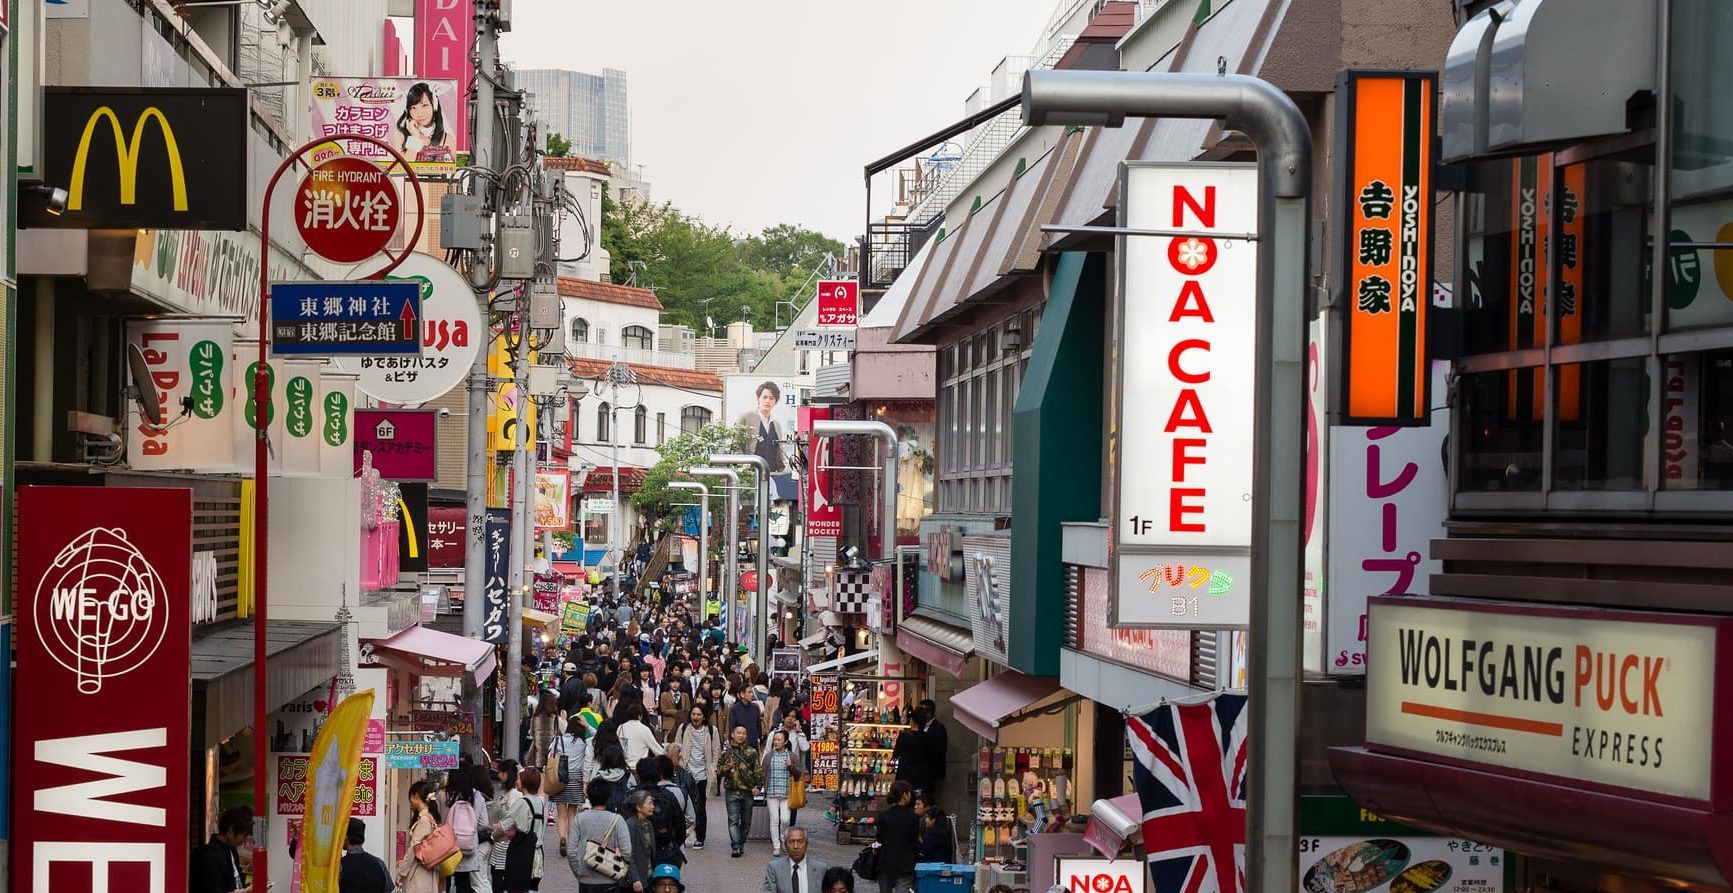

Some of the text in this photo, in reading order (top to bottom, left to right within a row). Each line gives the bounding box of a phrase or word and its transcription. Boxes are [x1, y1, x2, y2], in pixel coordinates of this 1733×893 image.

[334, 106, 389, 121] カラコン
[322, 123, 389, 139] つけまつげ
[312, 170, 383, 184] FIRE HYDRANT
[303, 188, 392, 232] 消火栓
[1167, 184, 1218, 324] NOA
[1357, 178, 1396, 316] 吉野家
[1400, 185, 1419, 312] YOSHINOYA
[298, 296, 392, 317] 東郷神社
[826, 313, 857, 323] アガサ
[299, 321, 398, 342] 東郷記念館
[817, 334, 854, 348] クリスティー
[199, 342, 215, 417] ラパウザ
[293, 378, 306, 436] ラパウザ
[330, 393, 342, 446] ラパウザ
[378, 426, 393, 437] 6F
[1163, 338, 1214, 533] CAFE
[1361, 425, 1422, 599] レープ
[428, 521, 466, 535] セサリー
[808, 520, 841, 528] WONDER
[809, 528, 841, 536] ROCKET
[1129, 515, 1153, 535] 1F
[484, 576, 507, 641] ハセガワ
[1171, 595, 1199, 617] B1
[1398, 627, 1566, 705] WOLFGANG
[1573, 643, 1664, 718] PUCK
[812, 690, 838, 711] 50
[385, 743, 443, 755] アクセサリー
[1571, 726, 1664, 769] EXPRESS
[420, 753, 458, 768] ¥324
[813, 759, 838, 768] SALE
[353, 784, 374, 803] etc
[1299, 839, 1321, 852] 3F
[1069, 872, 1134, 893] NOA
